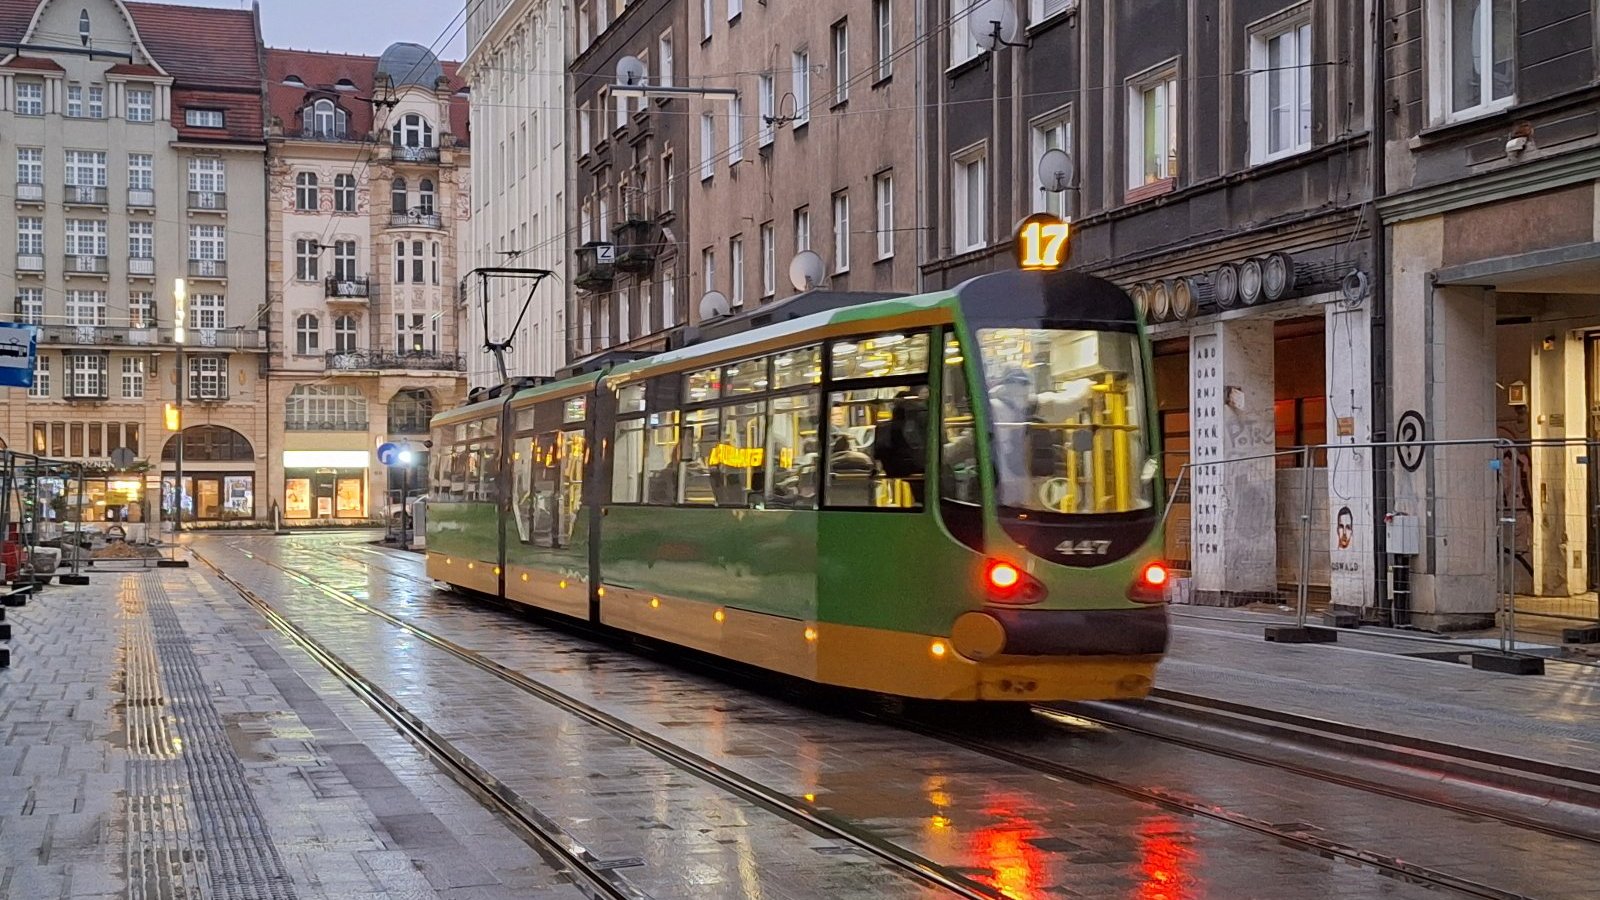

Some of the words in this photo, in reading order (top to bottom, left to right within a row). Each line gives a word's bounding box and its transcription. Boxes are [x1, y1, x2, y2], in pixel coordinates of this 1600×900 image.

[600, 246, 612, 258] Z
[1020, 222, 1068, 267] 17
[1053, 540, 1112, 555] 447
